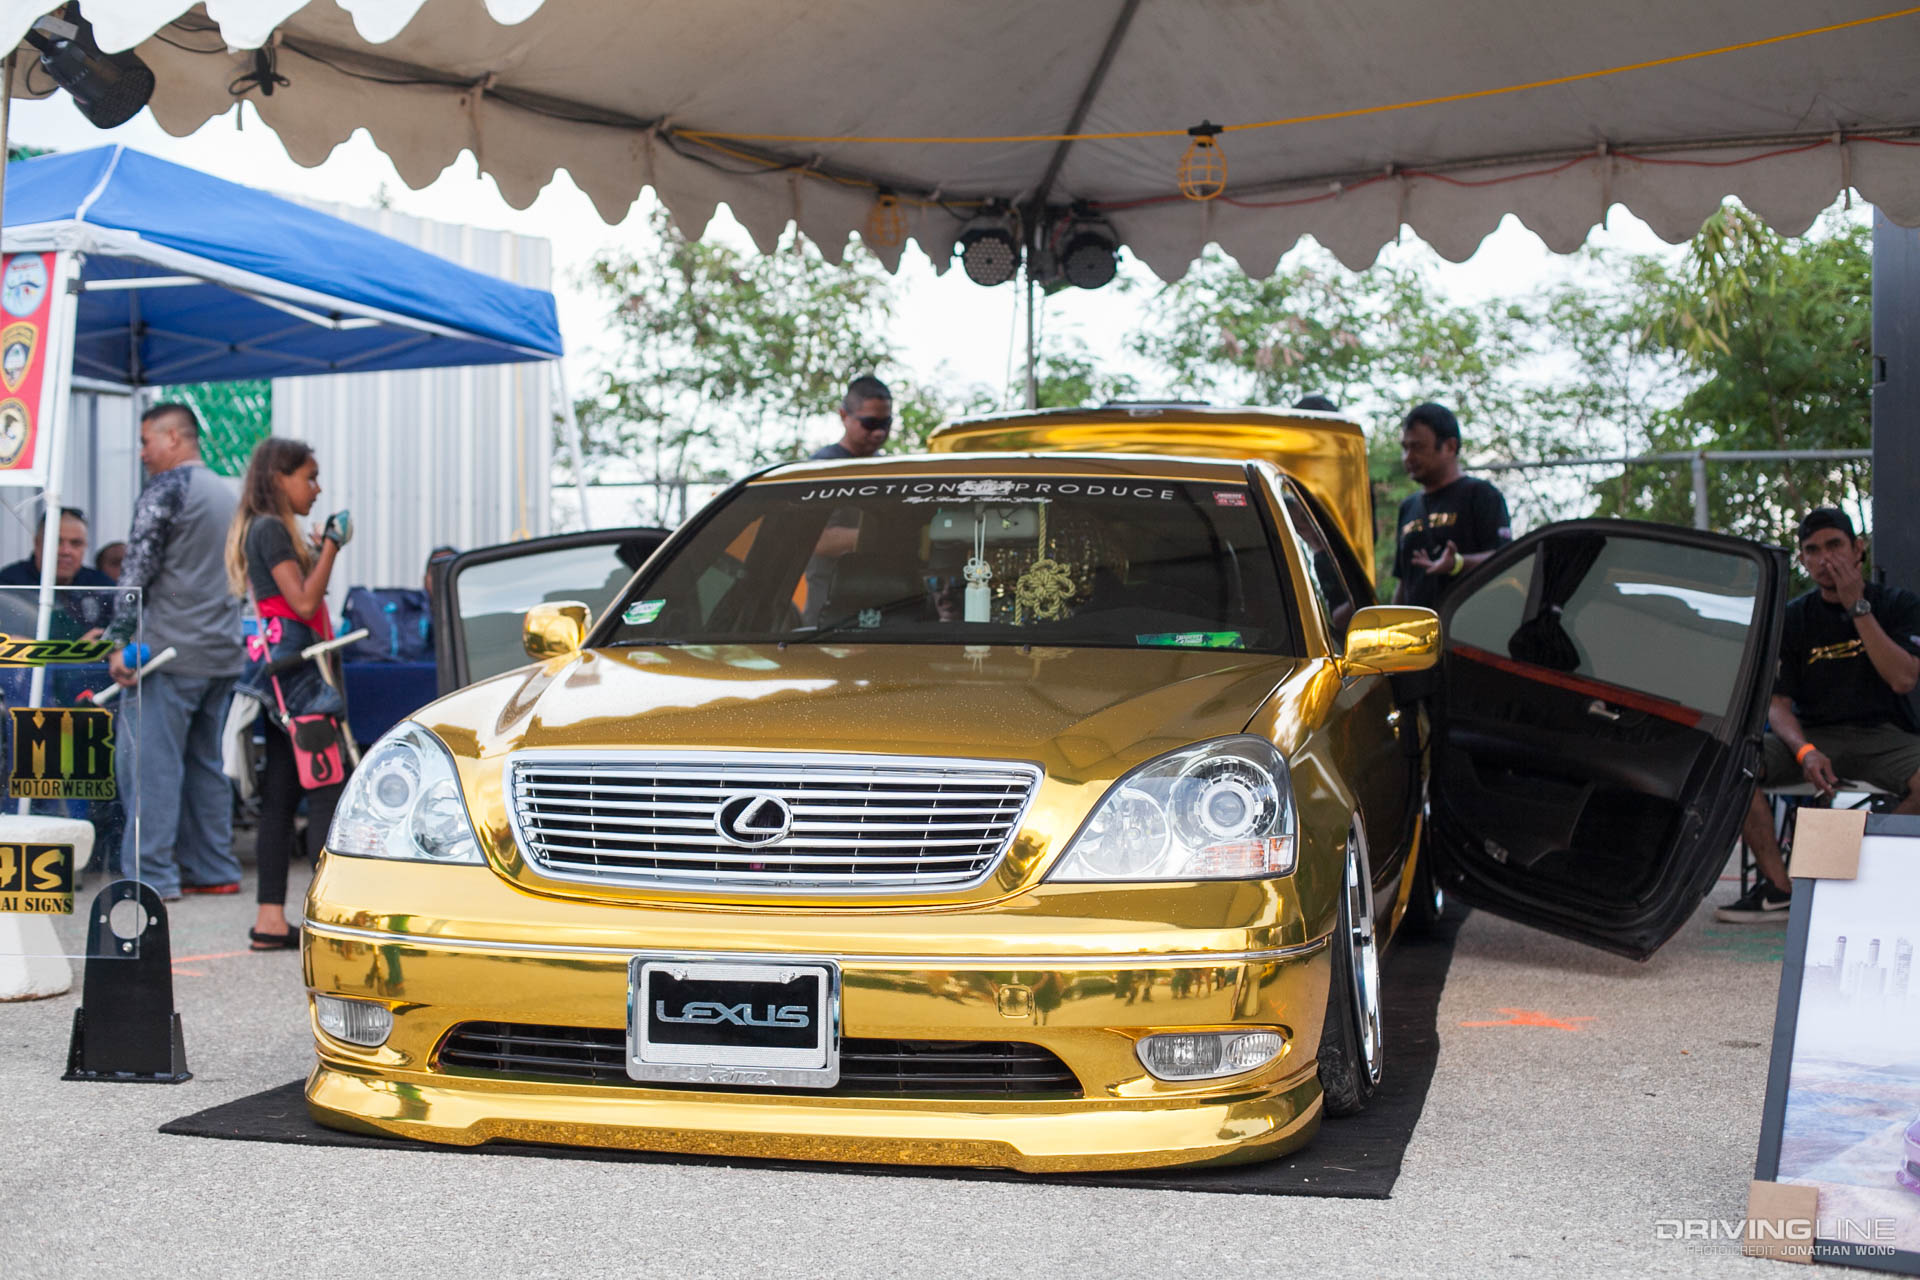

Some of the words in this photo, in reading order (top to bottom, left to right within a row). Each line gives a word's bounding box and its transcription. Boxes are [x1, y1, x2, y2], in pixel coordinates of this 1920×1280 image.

[801, 483, 957, 501] JUNCTION
[1015, 482, 1175, 500] PRODUCE
[11, 780, 114, 797] MOTORWERKS
[24, 897, 72, 912] SIGNS
[656, 1000, 810, 1028] LEXUS
